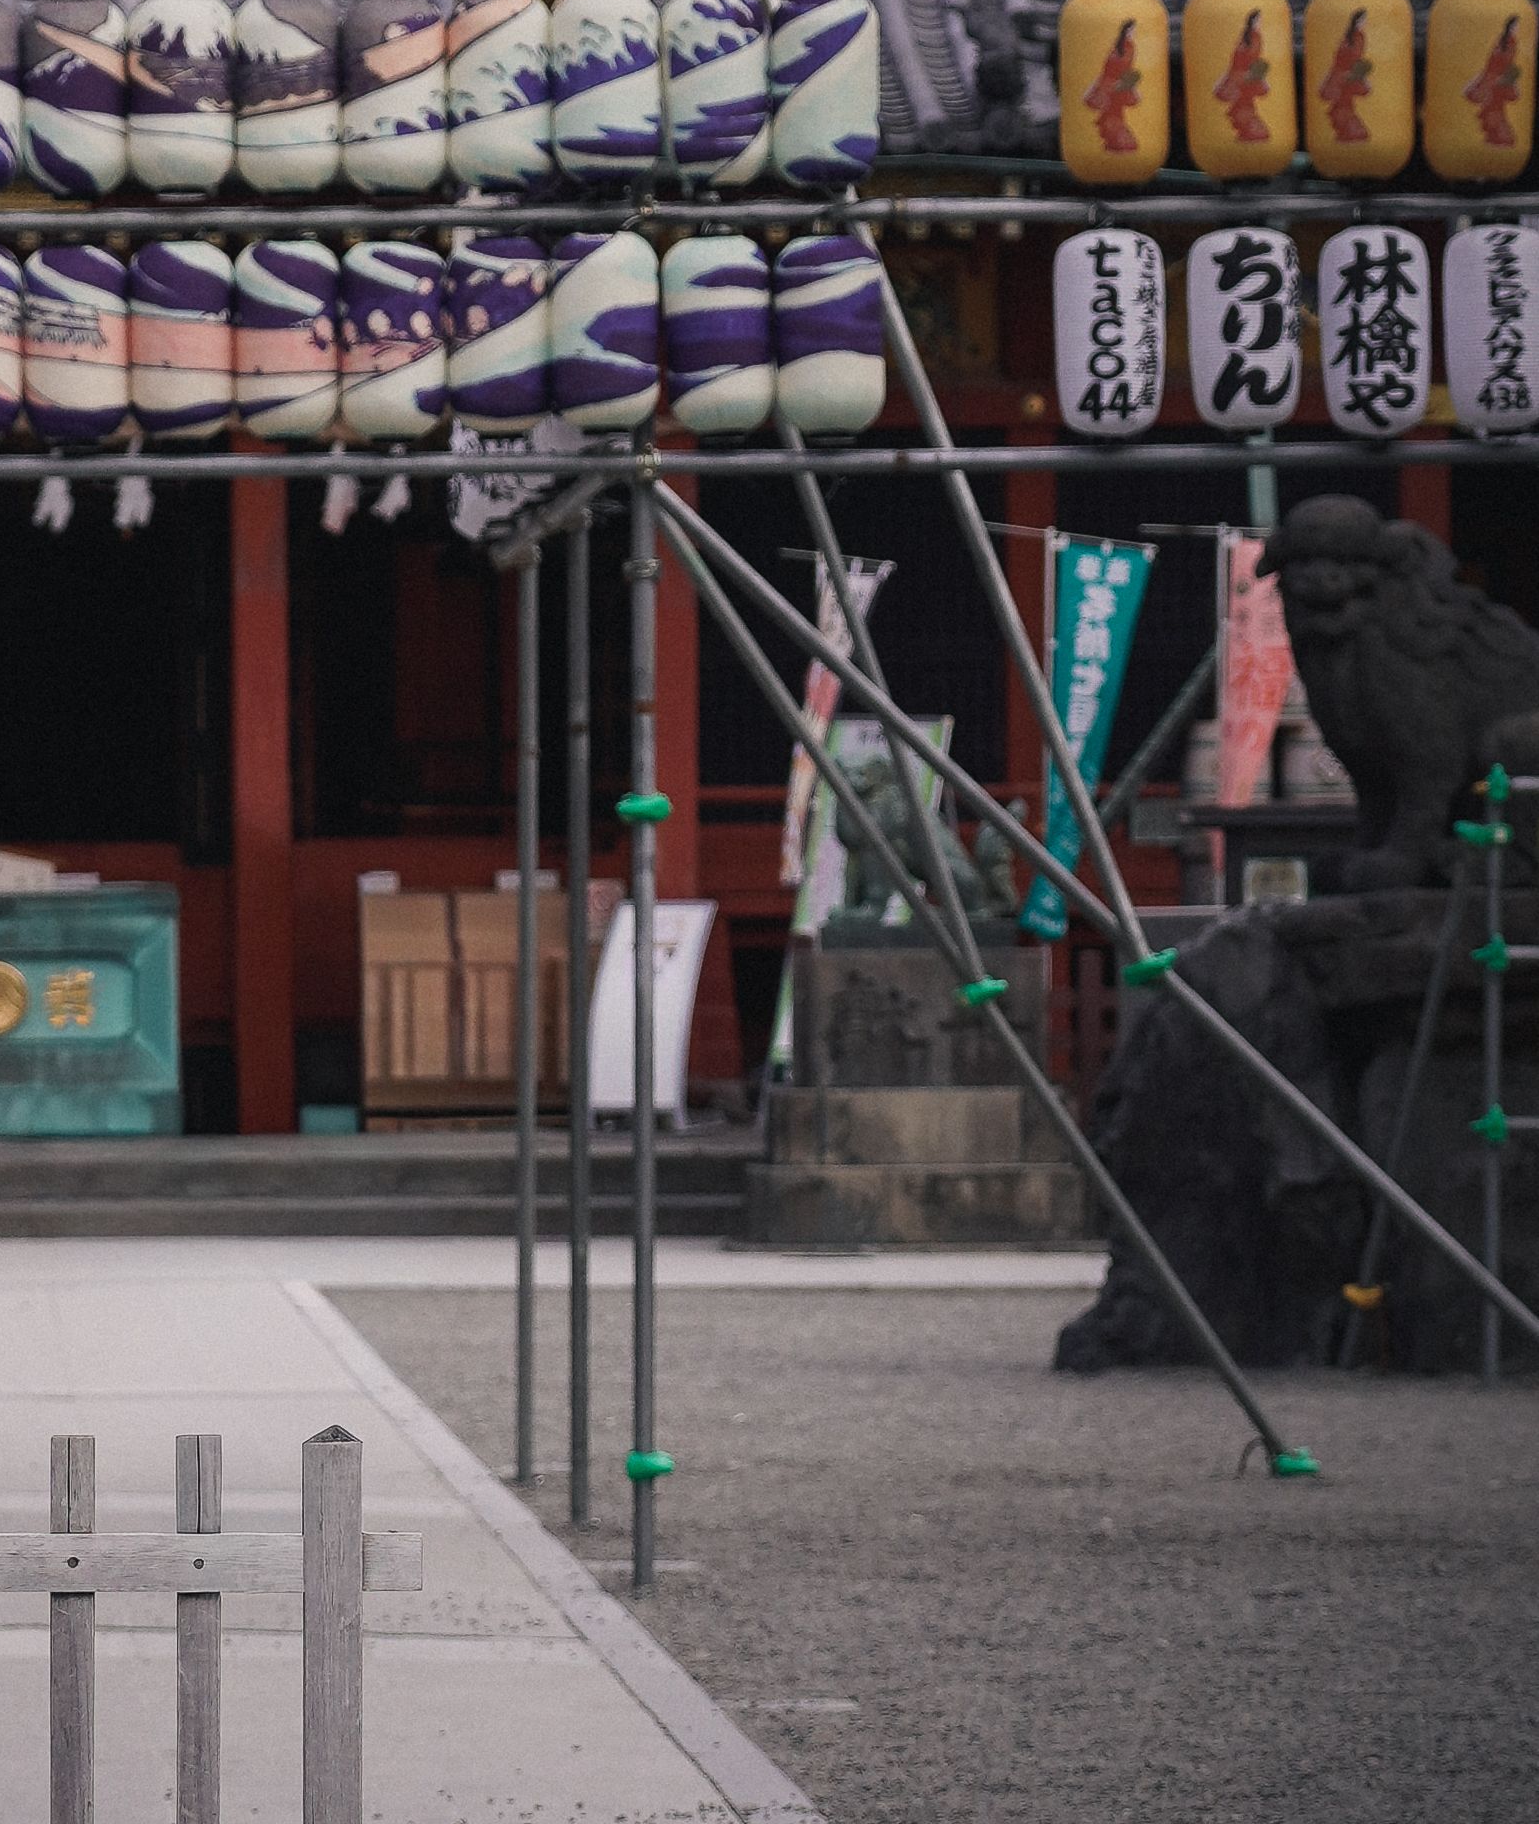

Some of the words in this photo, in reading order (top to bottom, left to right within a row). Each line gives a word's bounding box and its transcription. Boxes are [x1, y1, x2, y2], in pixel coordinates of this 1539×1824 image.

[1212, 232, 1293, 412] ちりん
[1331, 231, 1419, 428] 林檎や
